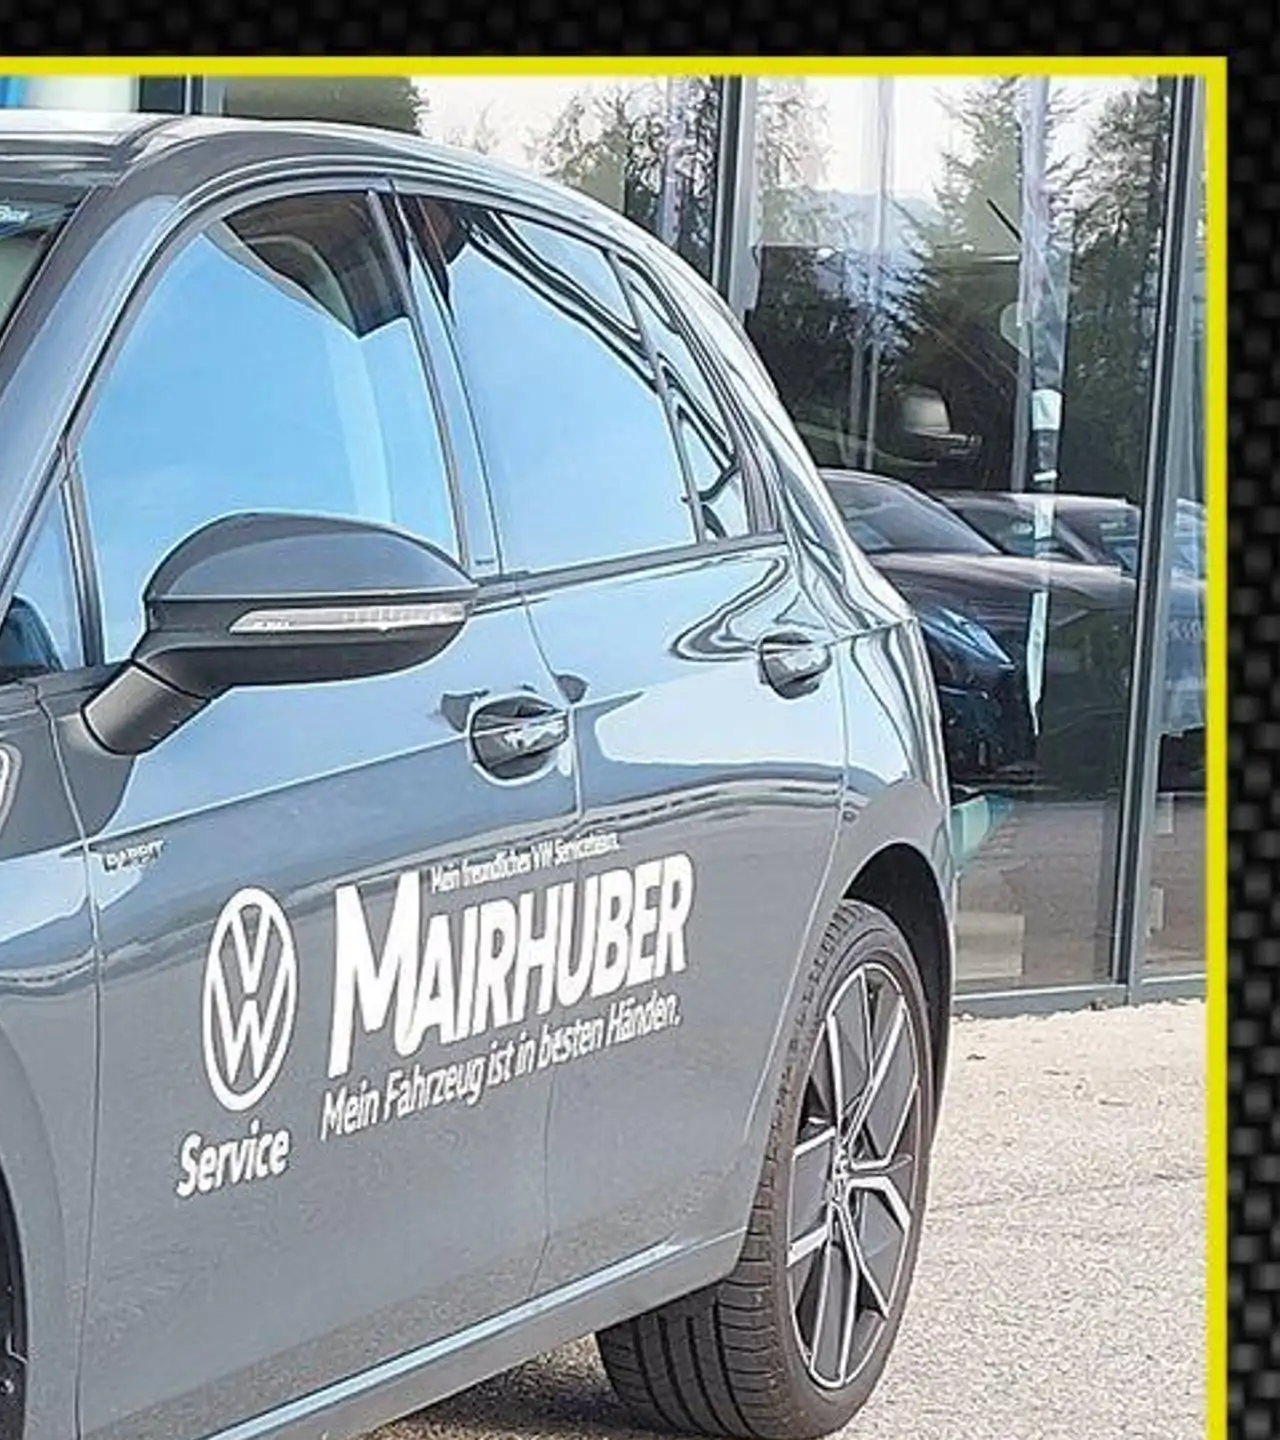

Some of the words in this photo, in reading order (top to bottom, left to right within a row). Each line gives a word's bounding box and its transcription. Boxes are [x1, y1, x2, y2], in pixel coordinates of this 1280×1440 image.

[319, 1079, 379, 1142] Mein
[383, 1063, 484, 1122] Fahrzeug
[487, 1040, 515, 1087] ist
[516, 1032, 536, 1077] in
[537, 1014, 603, 1069] besten
[605, 988, 682, 1048] Händen.
[176, 1118, 290, 1198] Service
